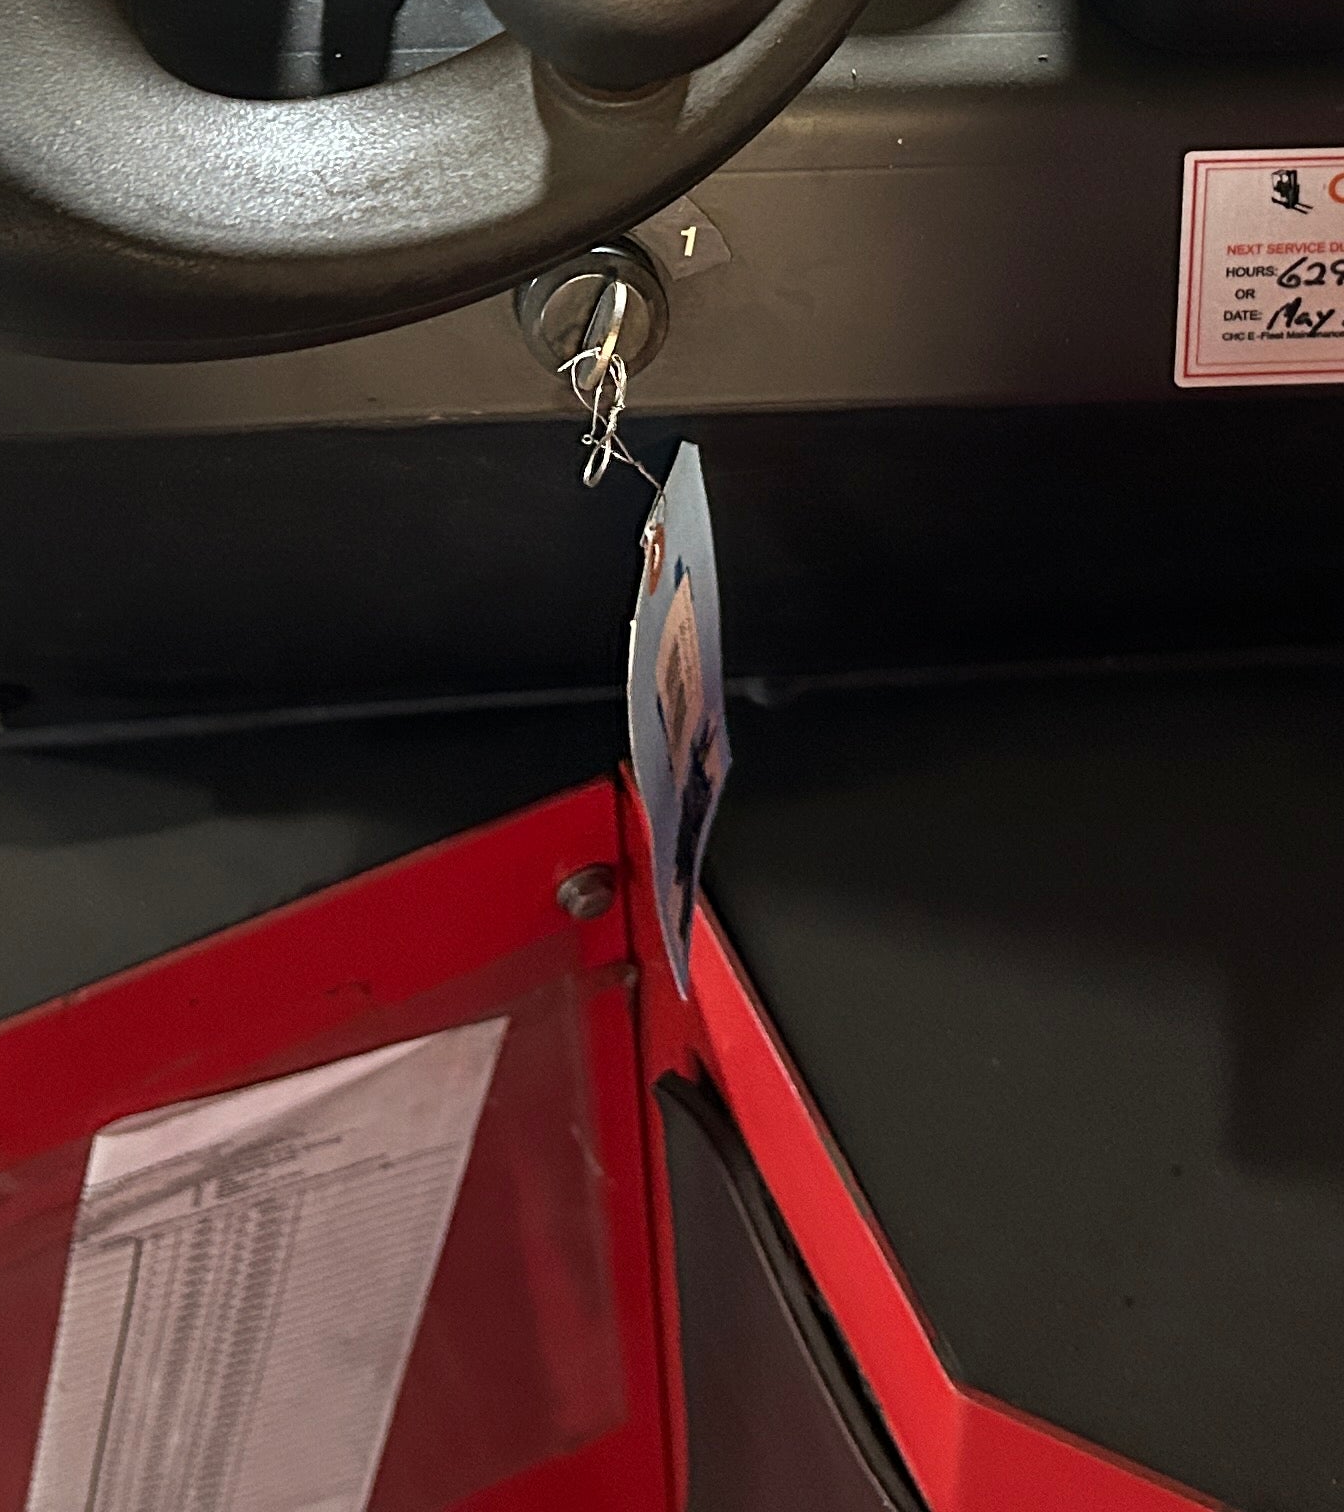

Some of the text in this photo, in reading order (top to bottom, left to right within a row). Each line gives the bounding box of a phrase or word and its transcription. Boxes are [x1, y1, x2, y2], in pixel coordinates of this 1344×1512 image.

[680, 226, 697, 257] 1
[1227, 244, 1262, 256] NEXT
[1266, 242, 1326, 255] SERVICE
[1226, 266, 1278, 278] HOURS:
[1235, 289, 1256, 300] OR
[1223, 309, 1262, 322] DATE:
[1266, 297, 1335, 337] May
